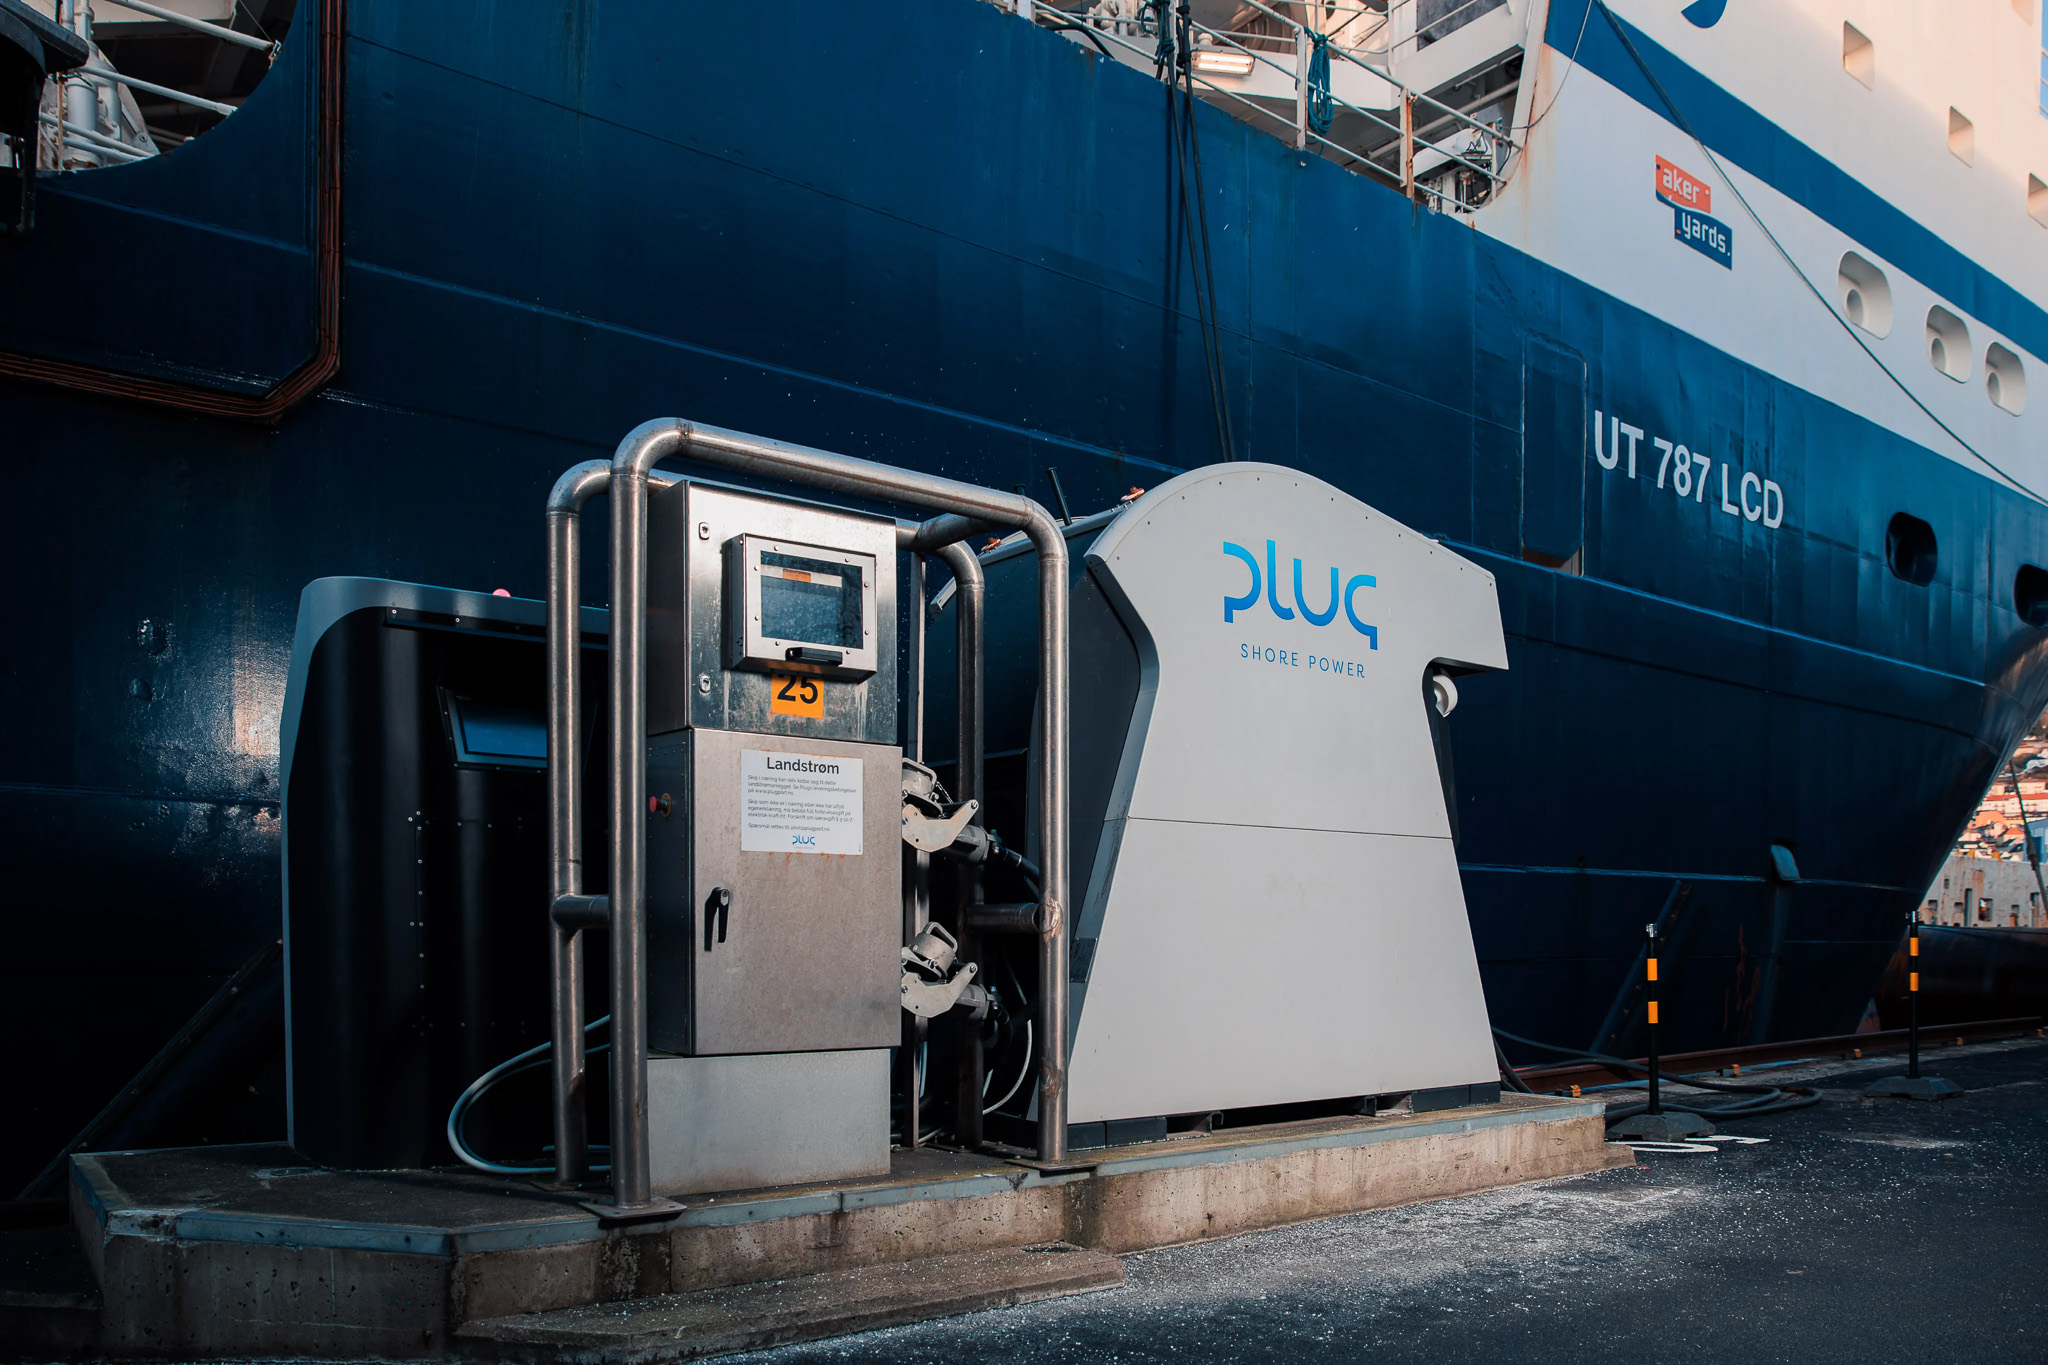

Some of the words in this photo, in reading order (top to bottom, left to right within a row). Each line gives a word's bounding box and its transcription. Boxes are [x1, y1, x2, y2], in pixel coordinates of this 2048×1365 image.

[1663, 168, 1700, 204] aker
[1682, 212, 1726, 254] yards
[1594, 410, 1644, 479] UT
[1654, 437, 1710, 503] 787
[1721, 463, 1783, 529] LCD
[1240, 643, 1298, 667] SHORE
[1309, 655, 1365, 678] POWER
[777, 674, 818, 704] 25
[767, 757, 839, 774] Landstrøm
